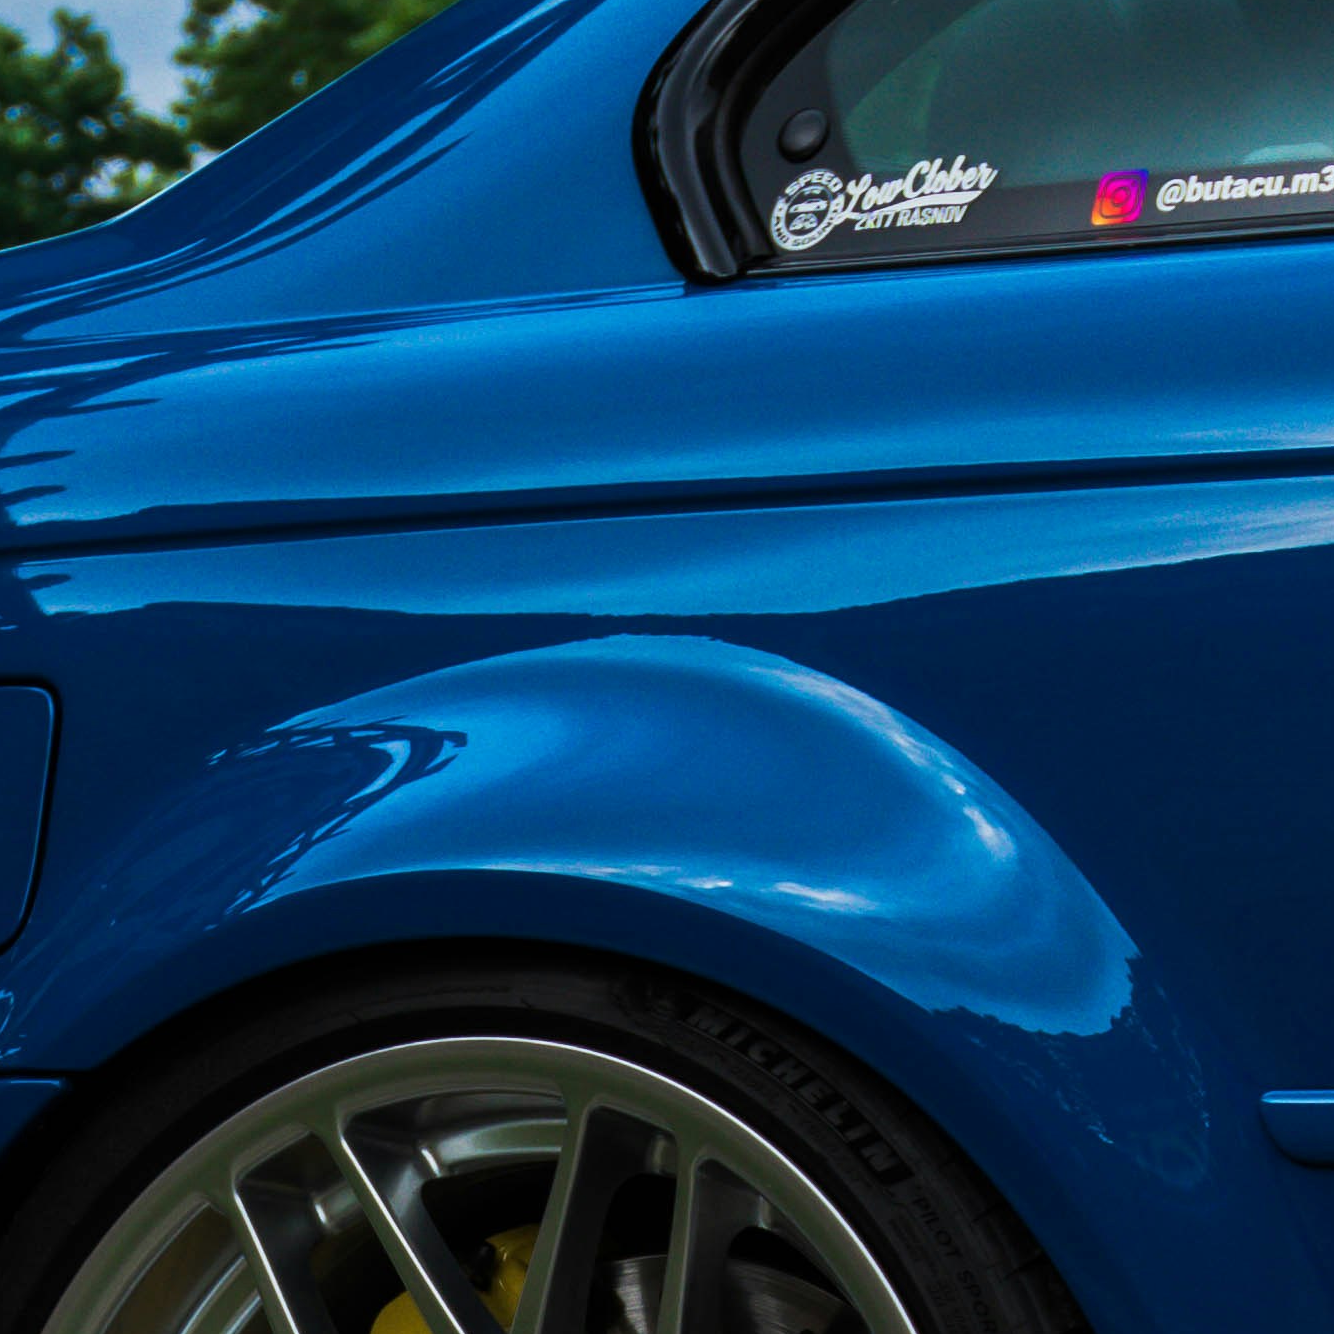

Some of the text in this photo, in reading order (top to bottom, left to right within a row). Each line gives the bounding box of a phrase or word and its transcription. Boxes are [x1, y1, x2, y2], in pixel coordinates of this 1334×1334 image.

[784, 171, 843, 196] SPEED
[685, 1004, 901, 1174] MICHELIN
[911, 1196, 964, 1259] PILOT
